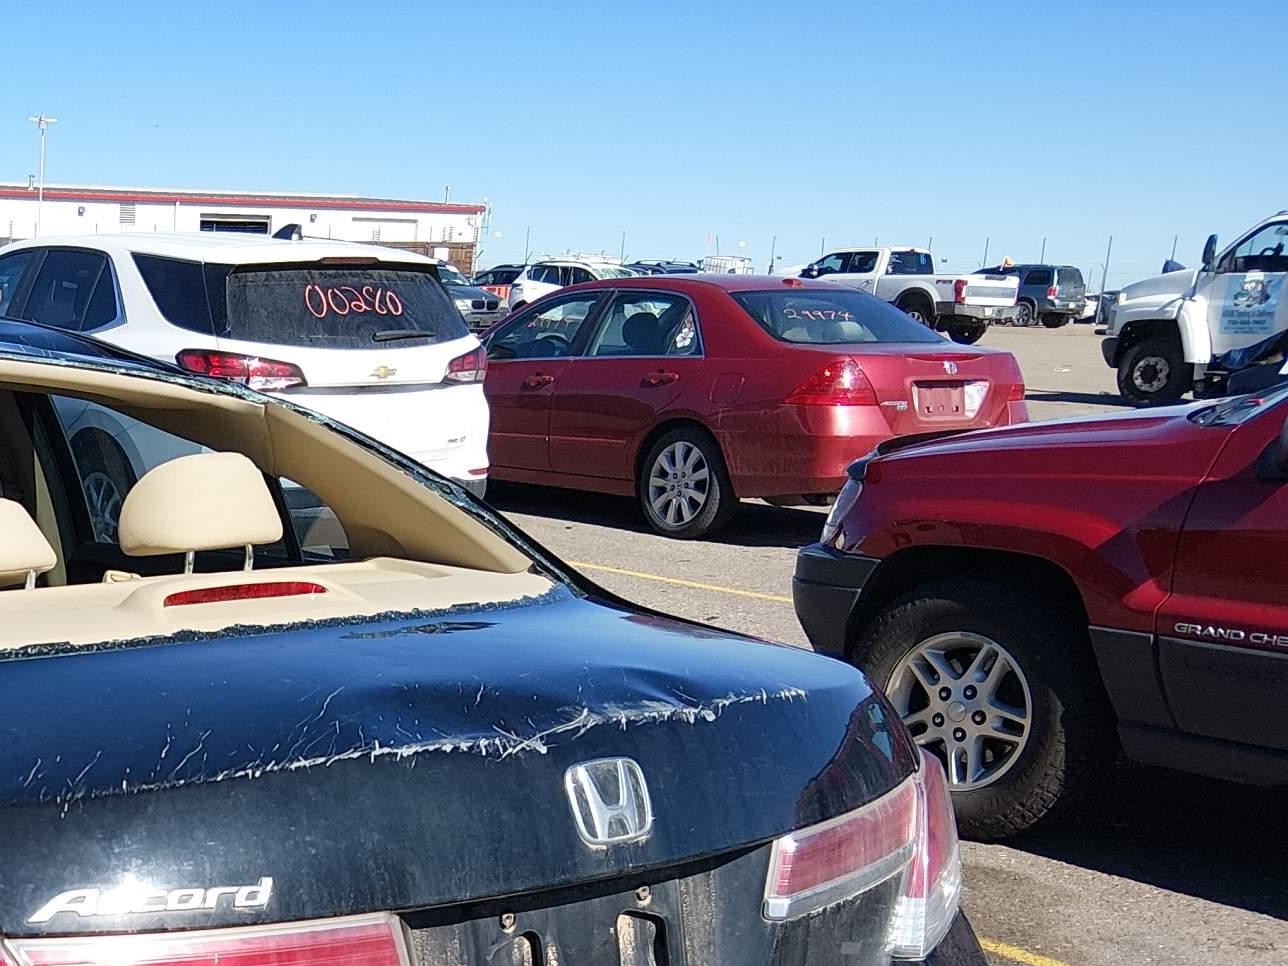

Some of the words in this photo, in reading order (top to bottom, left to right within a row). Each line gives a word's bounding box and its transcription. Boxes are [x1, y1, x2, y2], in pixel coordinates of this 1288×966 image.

[783, 308, 854, 321] 29974
[1174, 622, 1245, 640] GRAND
[25, 876, 273, 925] Acord
